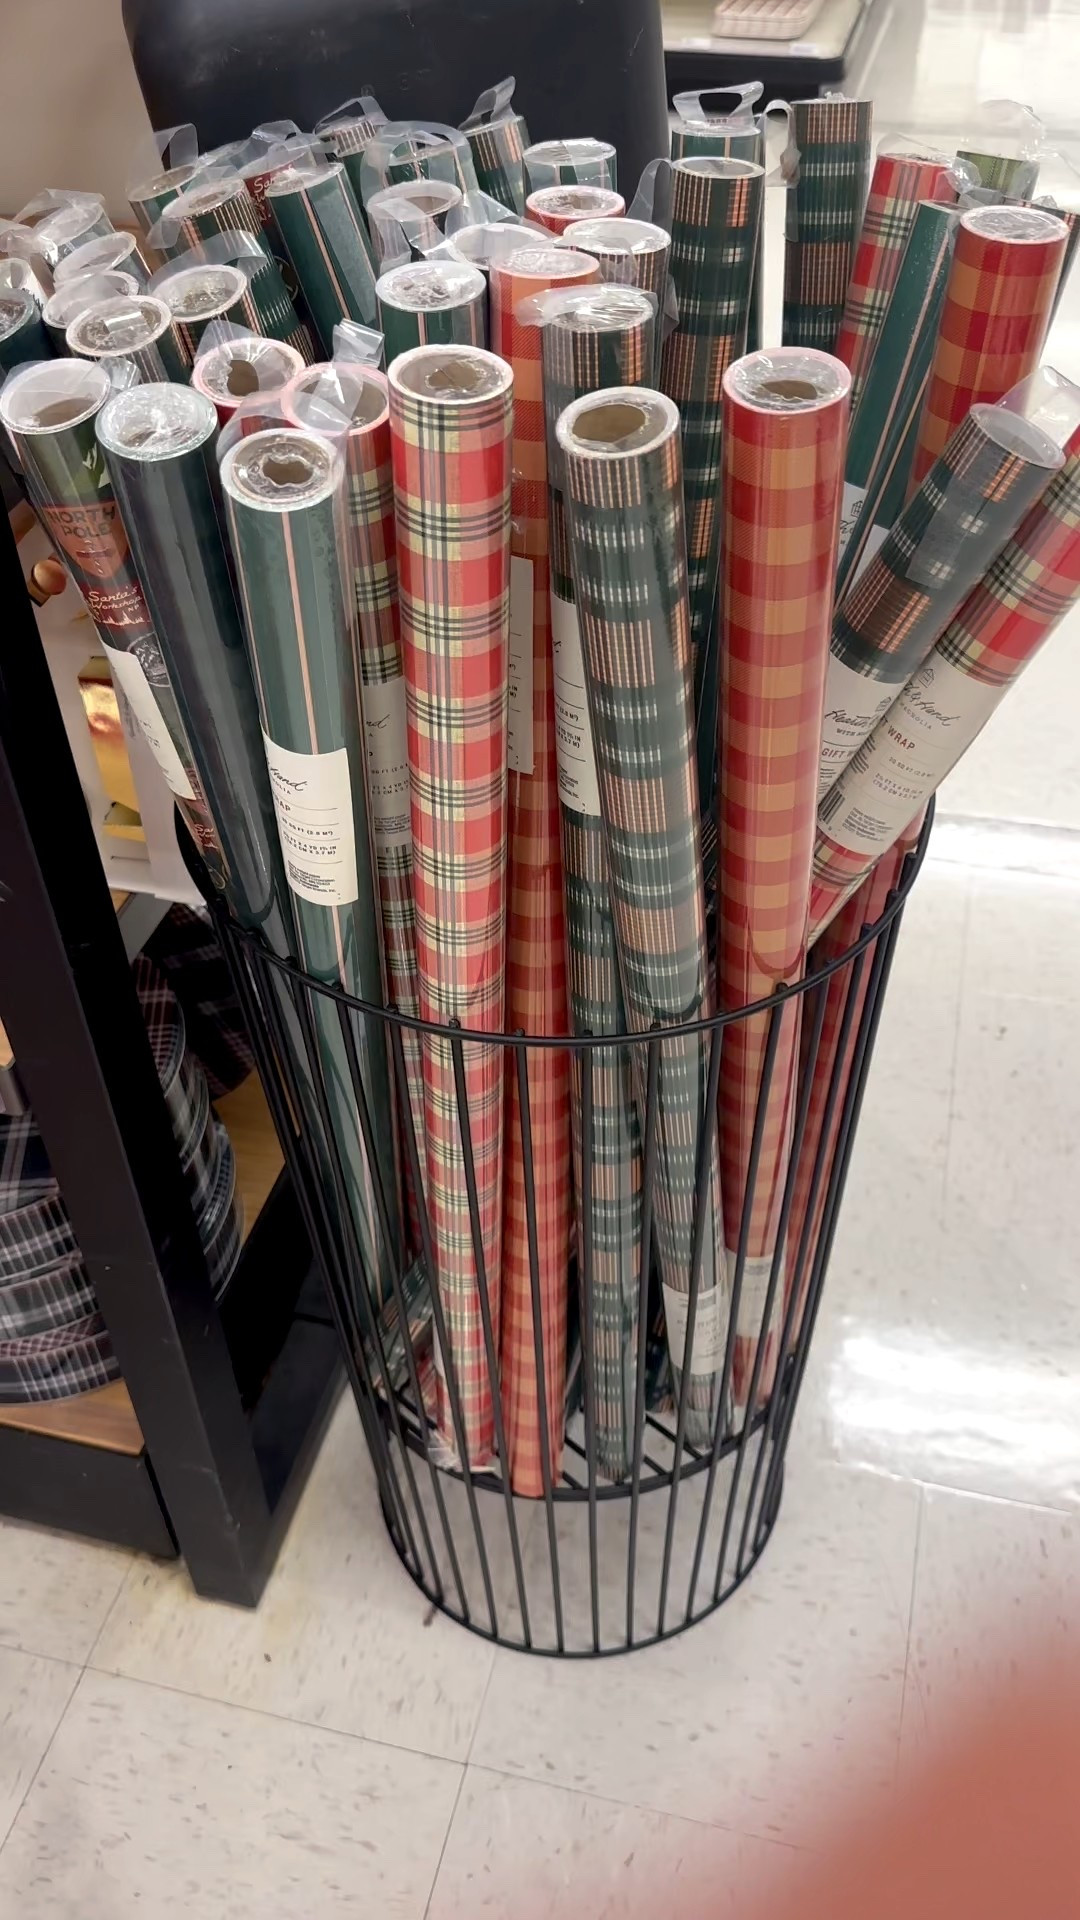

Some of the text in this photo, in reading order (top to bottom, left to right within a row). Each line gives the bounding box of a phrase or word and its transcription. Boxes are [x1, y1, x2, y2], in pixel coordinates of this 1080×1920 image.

[46, 505, 116, 524] NORTH
[62, 521, 112, 539] POLE
[88, 585, 138, 602] Santa's
[91, 596, 142, 611] Workshop
[914, 702, 961, 727] Hand
[836, 728, 856, 736] WITH
[887, 725, 915, 750] WRAP
[821, 748, 846, 759] GIFT
